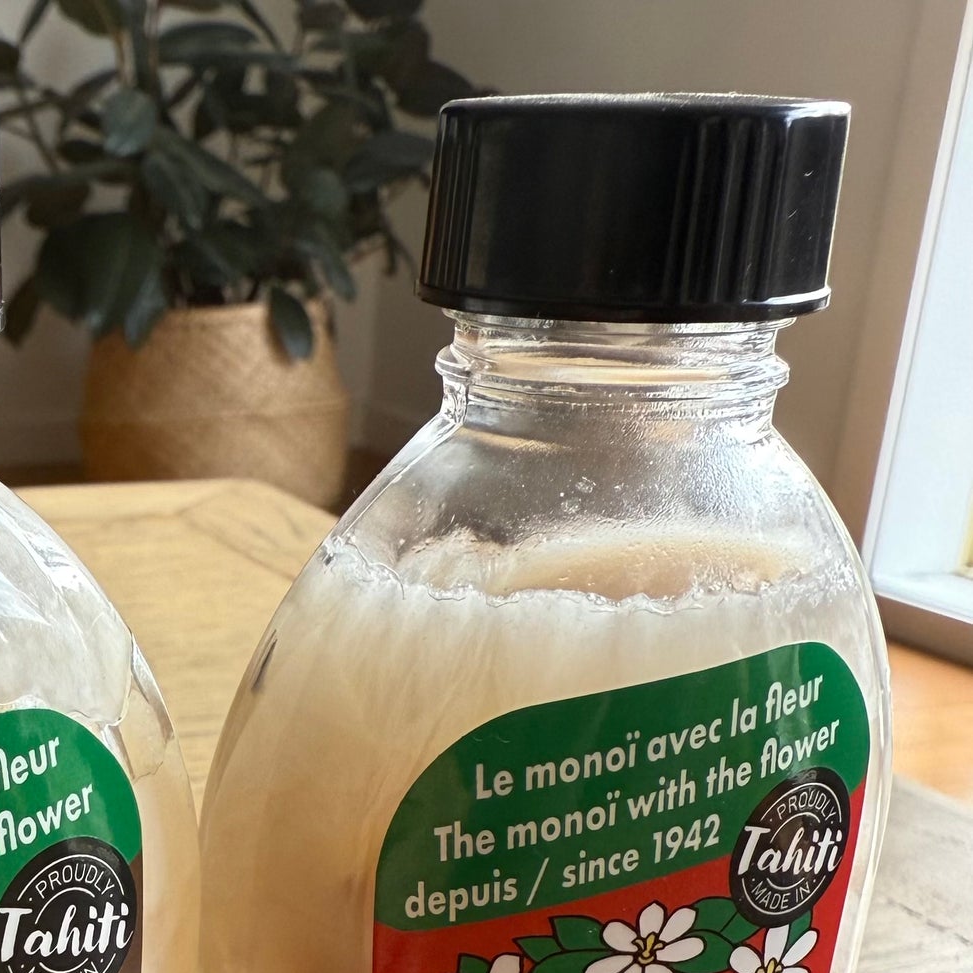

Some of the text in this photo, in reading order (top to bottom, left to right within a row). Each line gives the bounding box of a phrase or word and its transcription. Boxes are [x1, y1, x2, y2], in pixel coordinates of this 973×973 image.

[476, 674, 823, 799] Le monoï avec la fleur
[434, 719, 840, 862] The monoï with the flower
[776, 786, 836, 824] PROUDLY
[405, 868, 518, 922] depuis
[562, 849, 639, 888] since
[653, 813, 721, 864] 1942
[737, 826, 843, 876] Tahiti
[35, 863, 115, 899] PROUDLY
[751, 881, 810, 910] MADE IN
